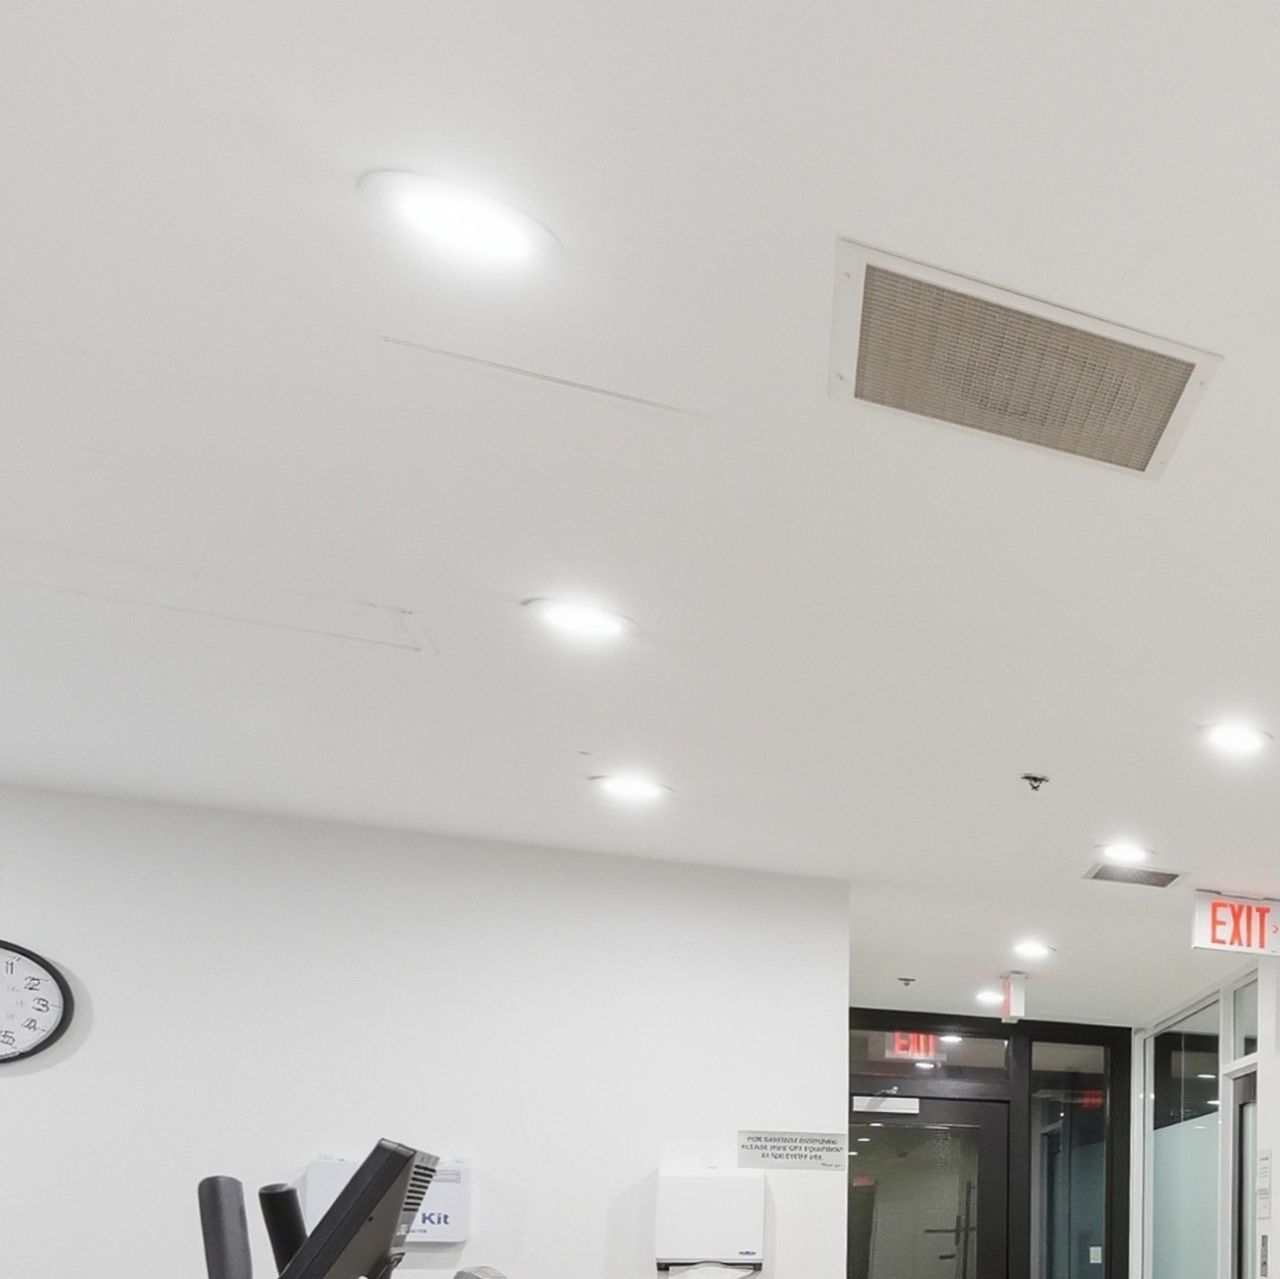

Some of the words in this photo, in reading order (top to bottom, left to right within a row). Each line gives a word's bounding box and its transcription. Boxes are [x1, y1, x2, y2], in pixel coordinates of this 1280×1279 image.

[1210, 901, 1271, 949] EXIT
[32, 997, 50, 1013] 3
[421, 1212, 449, 1225] Kit
